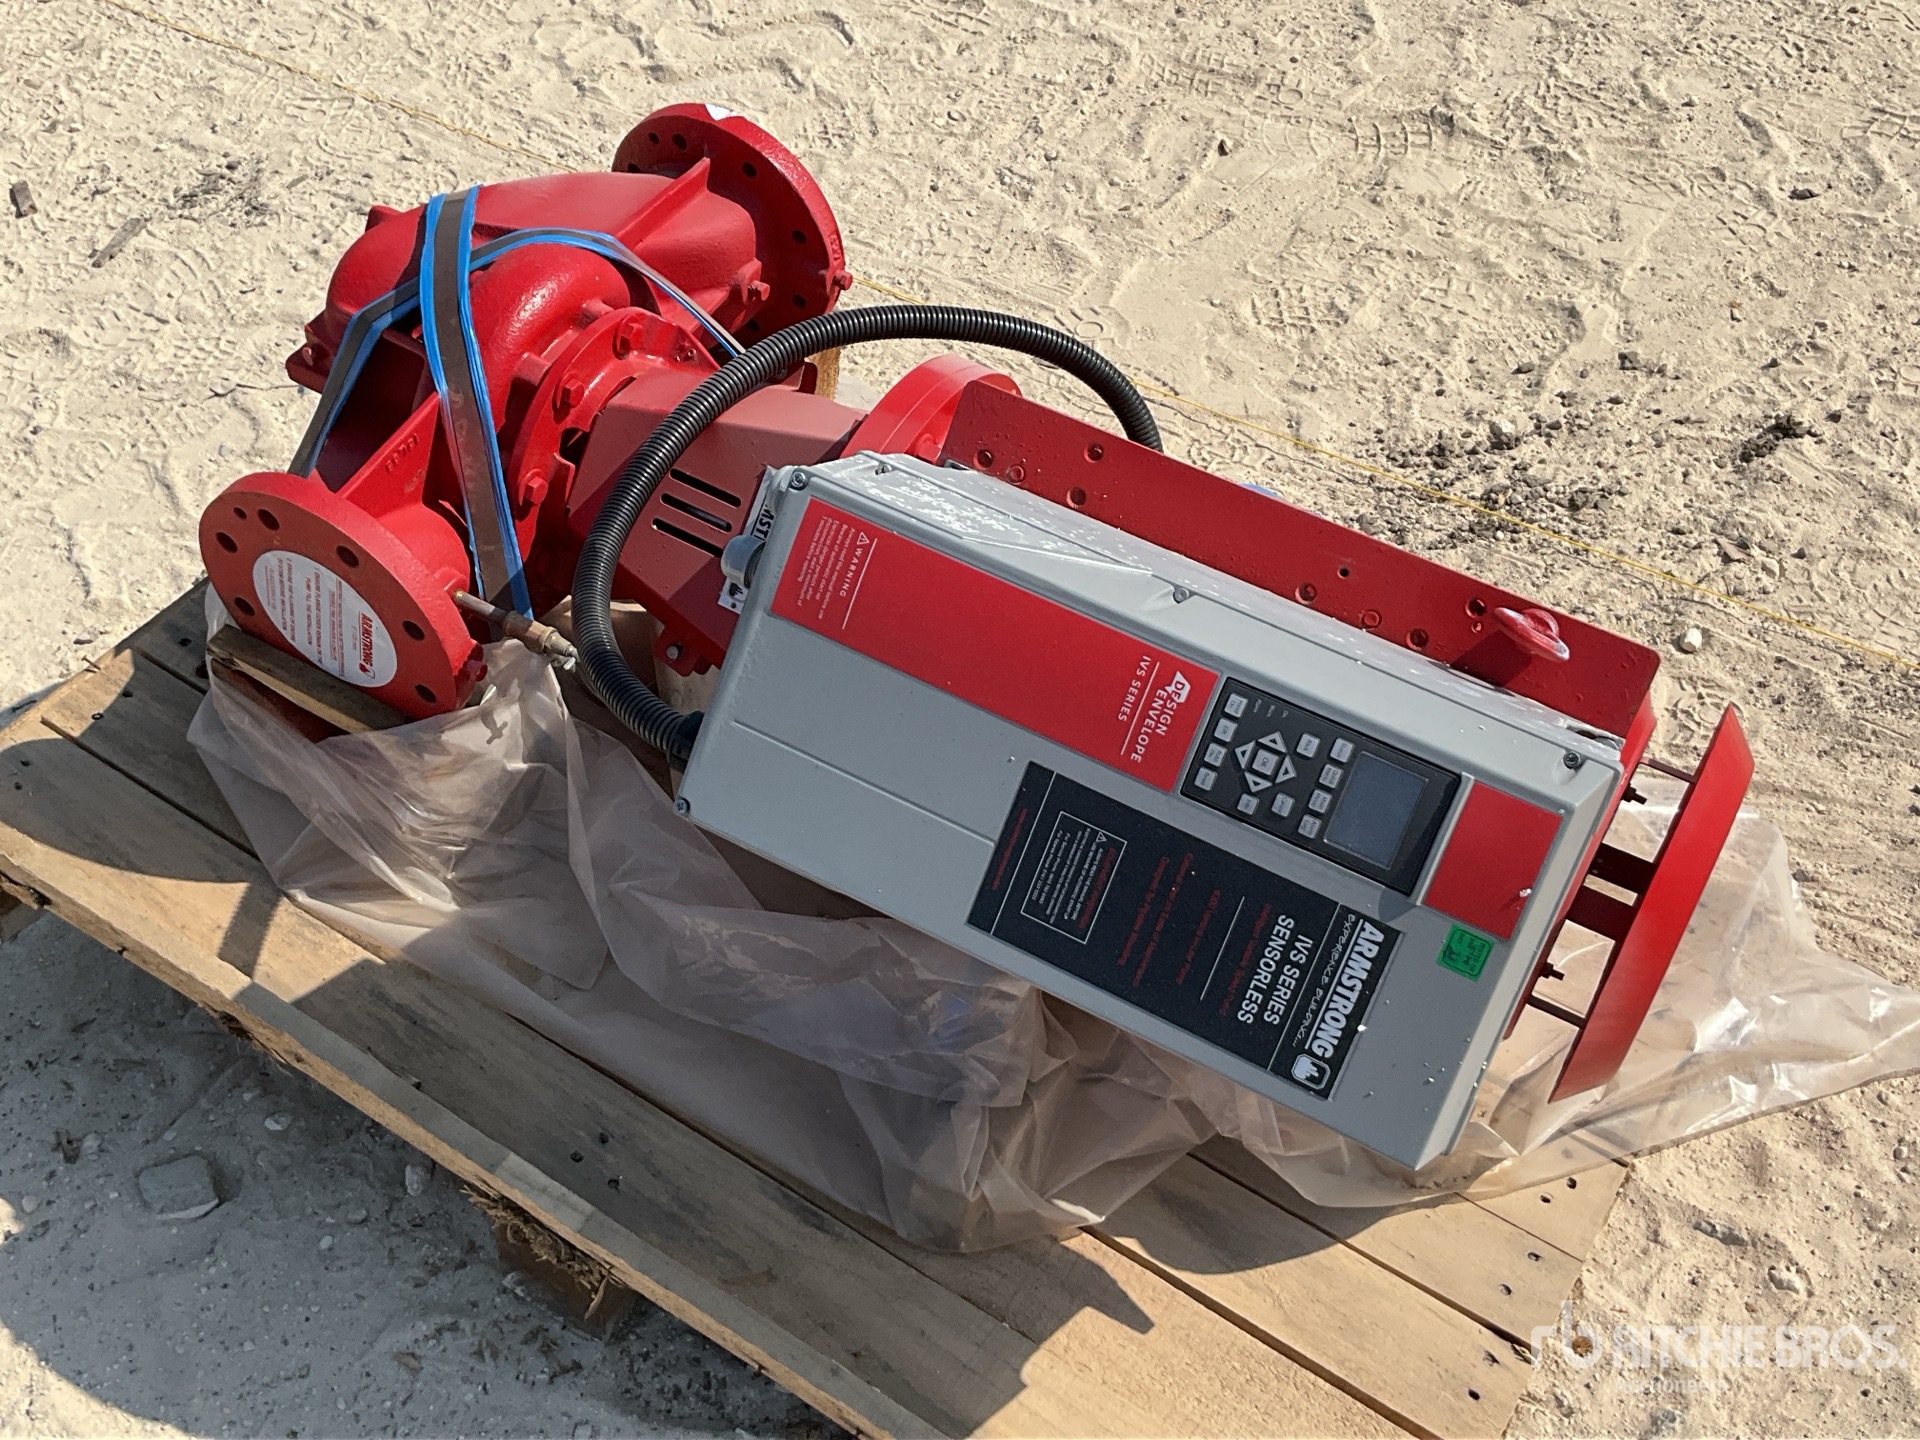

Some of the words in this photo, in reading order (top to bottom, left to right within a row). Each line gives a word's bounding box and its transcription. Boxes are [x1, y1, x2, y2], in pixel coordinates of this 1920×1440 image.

[812, 519, 825, 542] minutes
[825, 520, 839, 545] Electrical
[835, 523, 847, 544] Beware
[843, 527, 855, 548] Always
[806, 542, 816, 559] before
[809, 556, 817, 569] wait
[816, 545, 829, 565] danger
[838, 547, 847, 561] read
[797, 559, 809, 582] opening
[809, 564, 821, 586] persists
[822, 550, 836, 579] automatic
[838, 546, 862, 597] WARNING
[798, 573, 812, 599] minimum
[817, 578, 826, 592] start
[827, 570, 839, 591] manual
[804, 586, 813, 600] after
[821, 591, 831, 609] before
[361, 612, 372, 667] ARMSTRONG
[1135, 655, 1151, 677] IVS
[1117, 679, 1141, 721] SERIES
[1154, 679, 1185, 736] DESIGN
[1129, 688, 1167, 763] ENVELOPE
[1287, 933, 1313, 964] IVS
[1318, 912, 1355, 985] EXPERIENCE
[1235, 913, 1295, 1024] SENSORLESS
[1261, 963, 1300, 1025] SERIES
[1309, 920, 1383, 1059] ARMSTRONG
[1291, 986, 1324, 1048] BUILDING...
